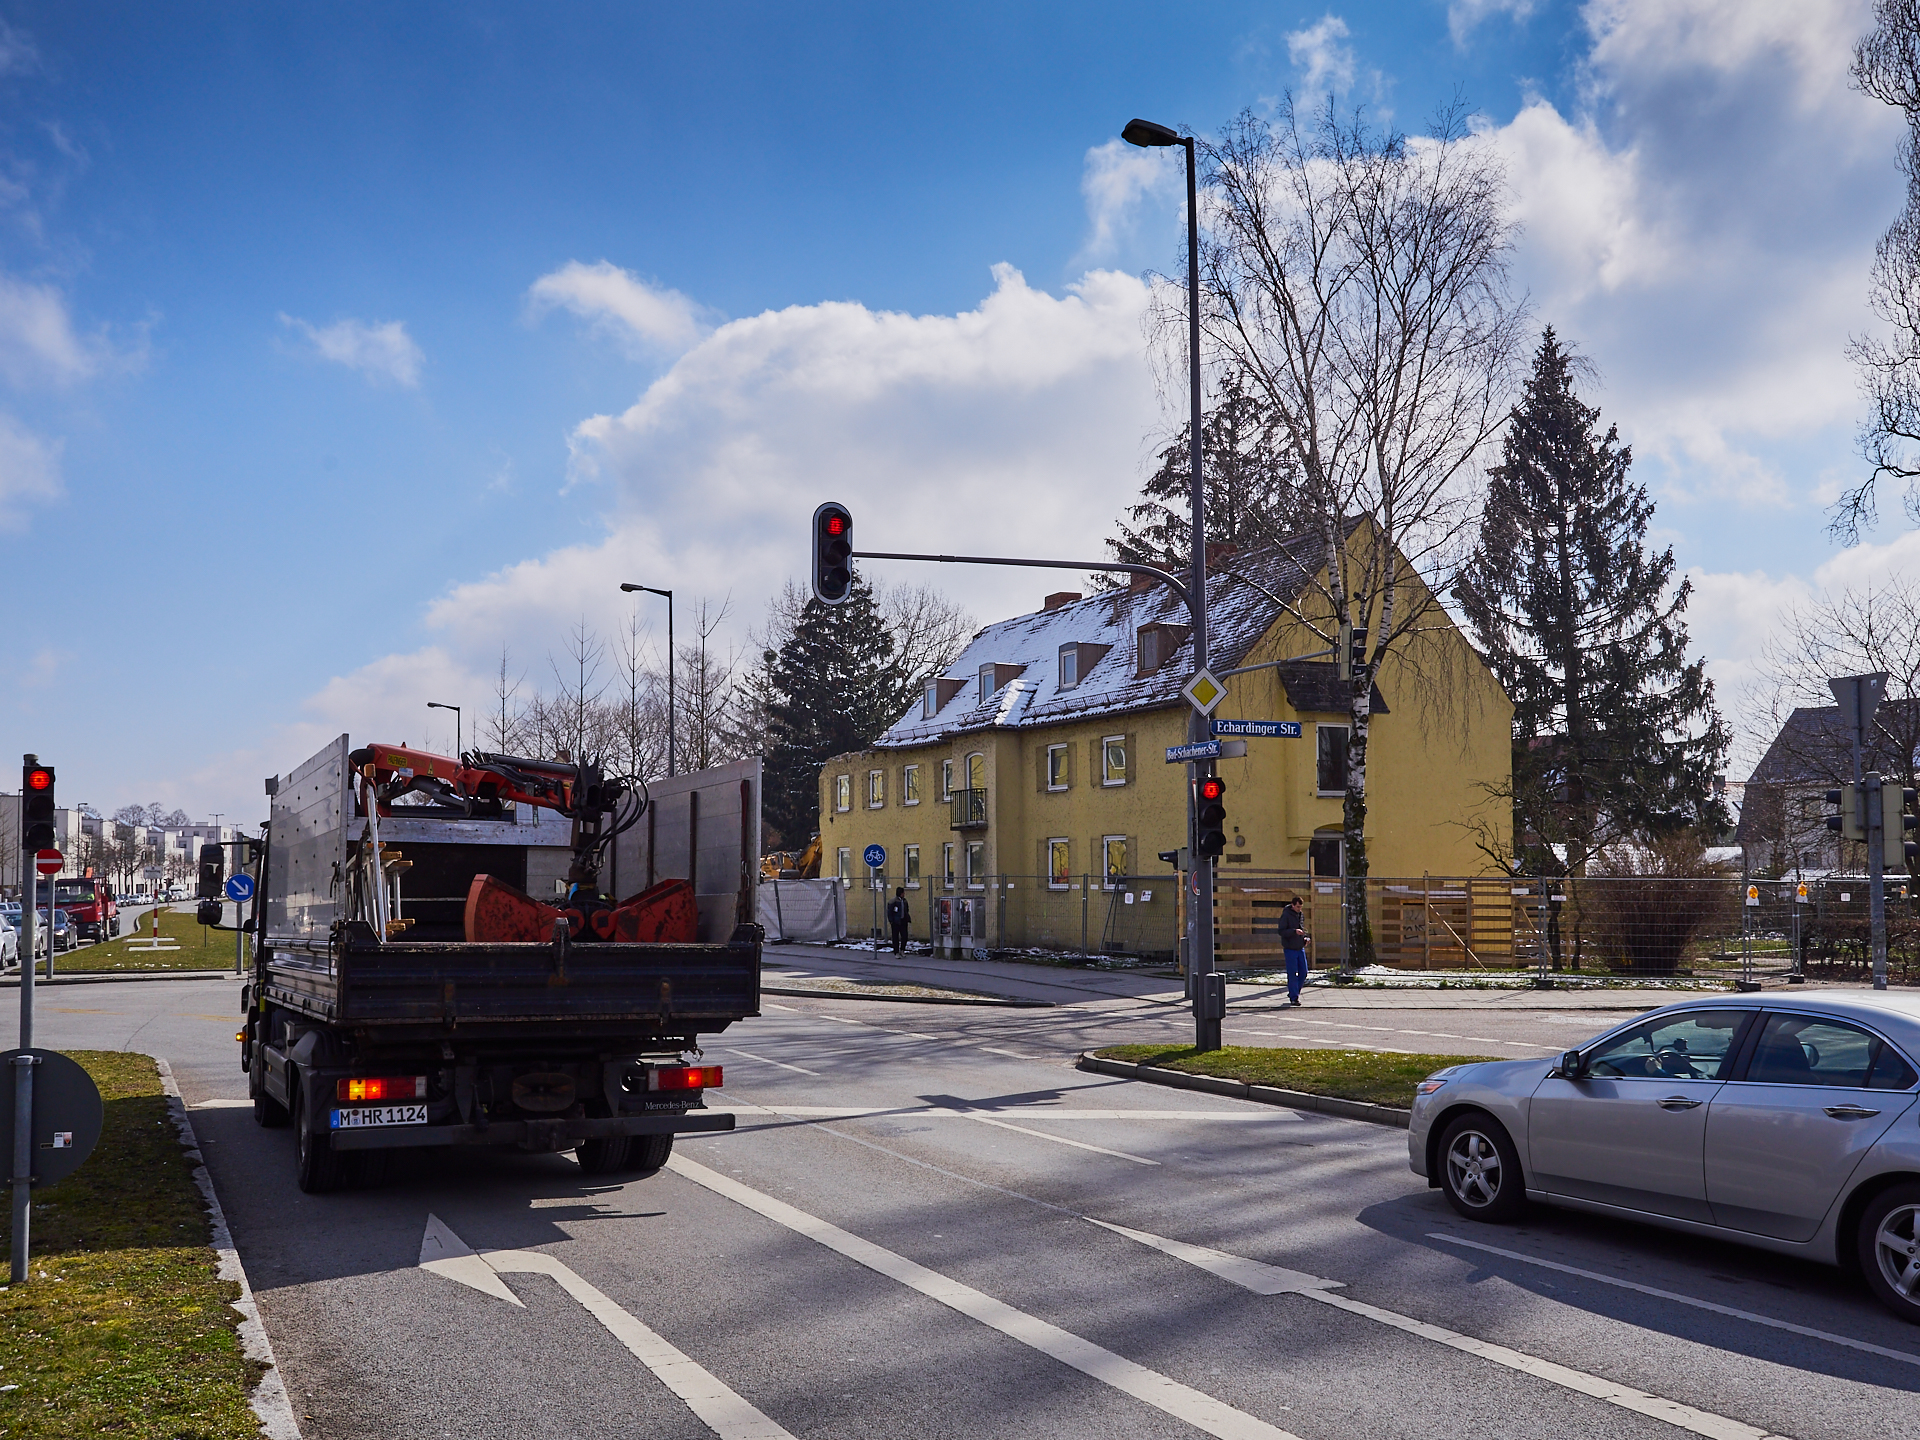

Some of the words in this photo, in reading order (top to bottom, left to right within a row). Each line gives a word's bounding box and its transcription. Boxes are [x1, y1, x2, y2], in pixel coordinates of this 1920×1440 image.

[1216, 721, 1278, 736] Echardinger
[1280, 723, 1298, 735] Str.
[645, 1100, 700, 1110] Mercedes-Benz
[340, 1111, 351, 1126] M
[386, 1105, 426, 1123] 1124
